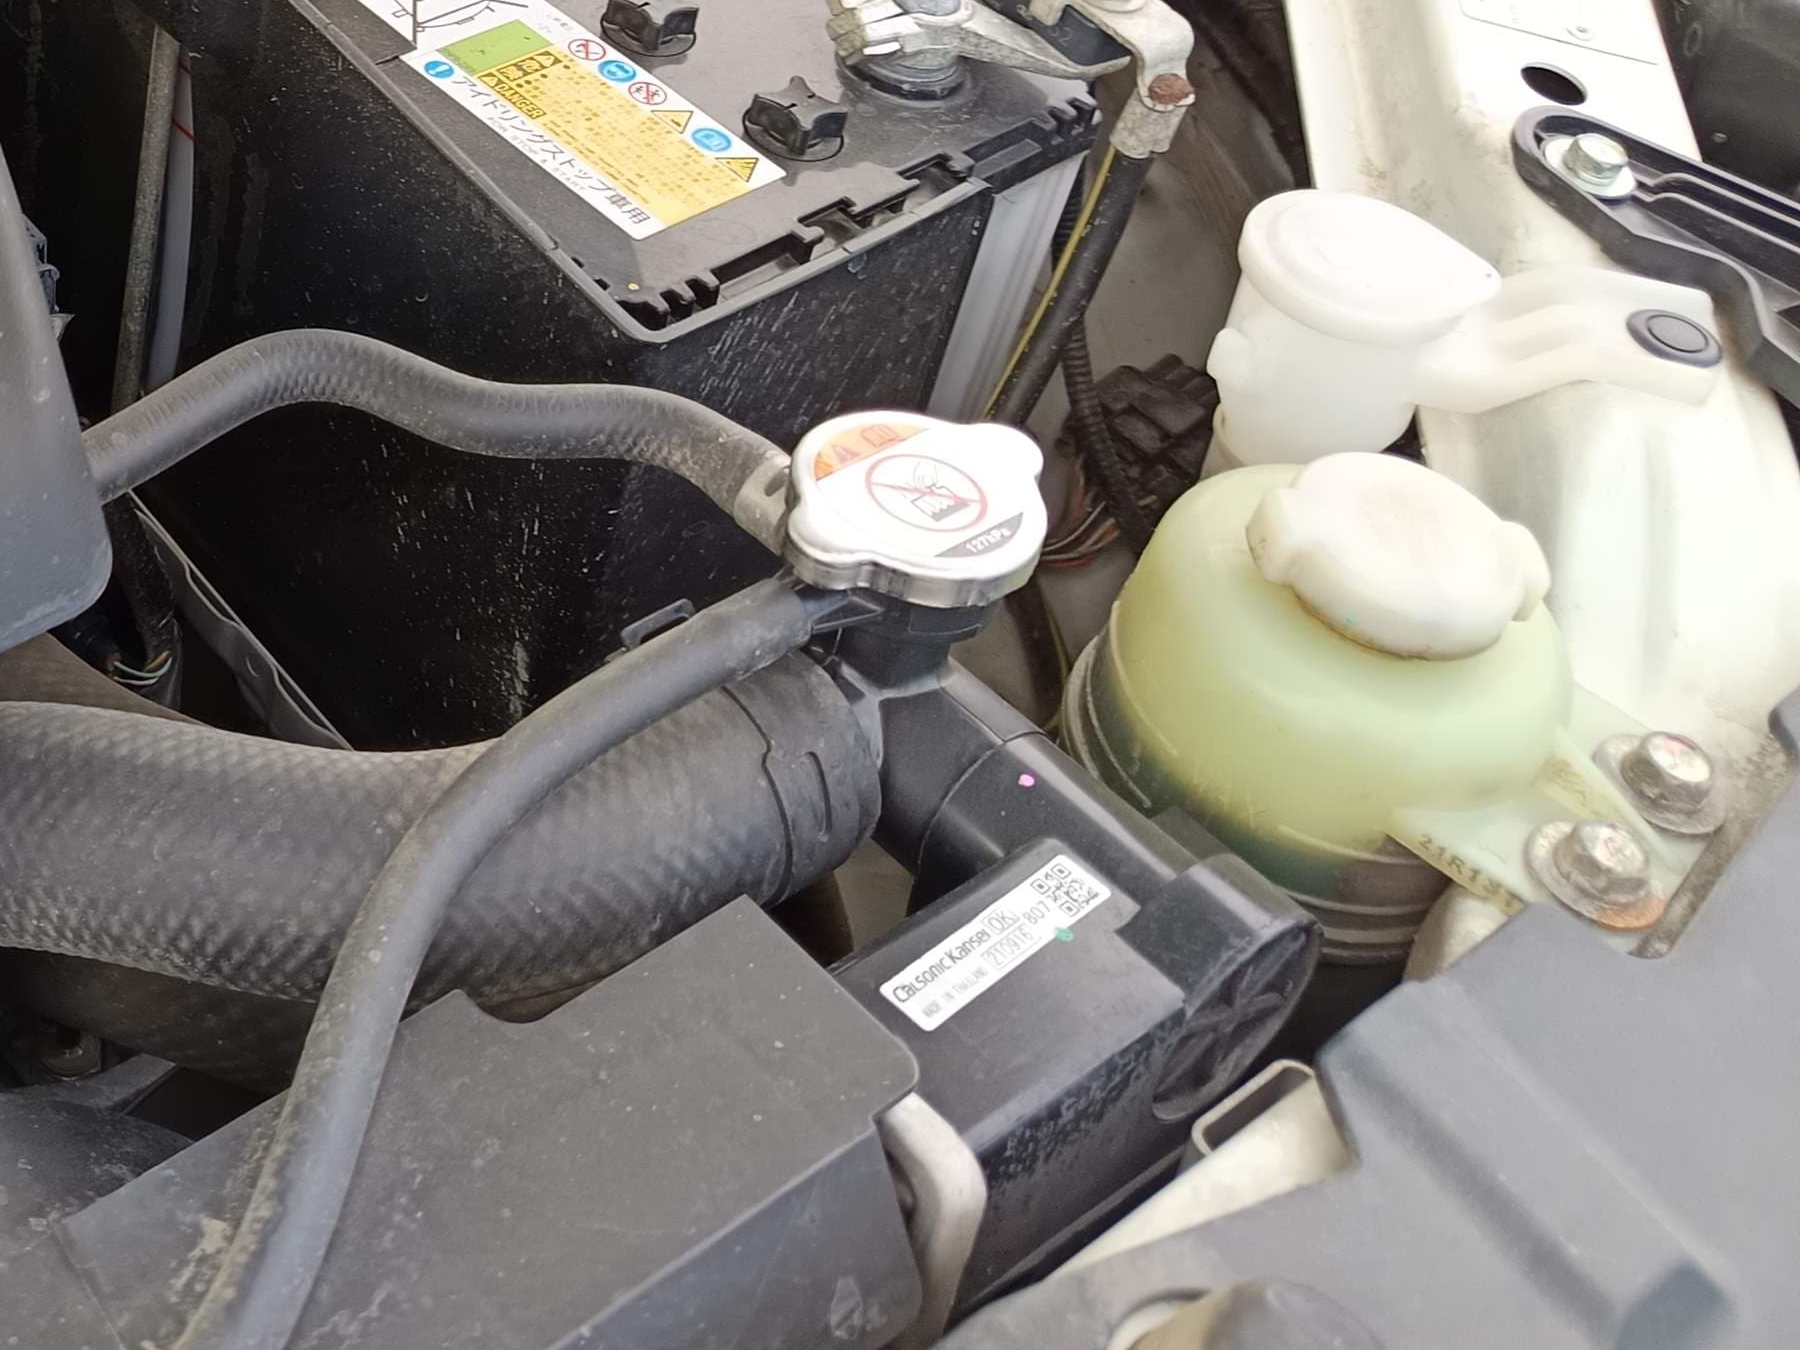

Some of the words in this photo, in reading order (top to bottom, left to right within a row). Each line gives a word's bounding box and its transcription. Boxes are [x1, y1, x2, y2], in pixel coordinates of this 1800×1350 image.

[494, 84, 544, 119] DANGER
[452, 76, 651, 225] アイドリングストップ車用
[965, 527, 1012, 554] 127kPa
[987, 910, 1014, 933] OK
[1023, 900, 1051, 925] 807
